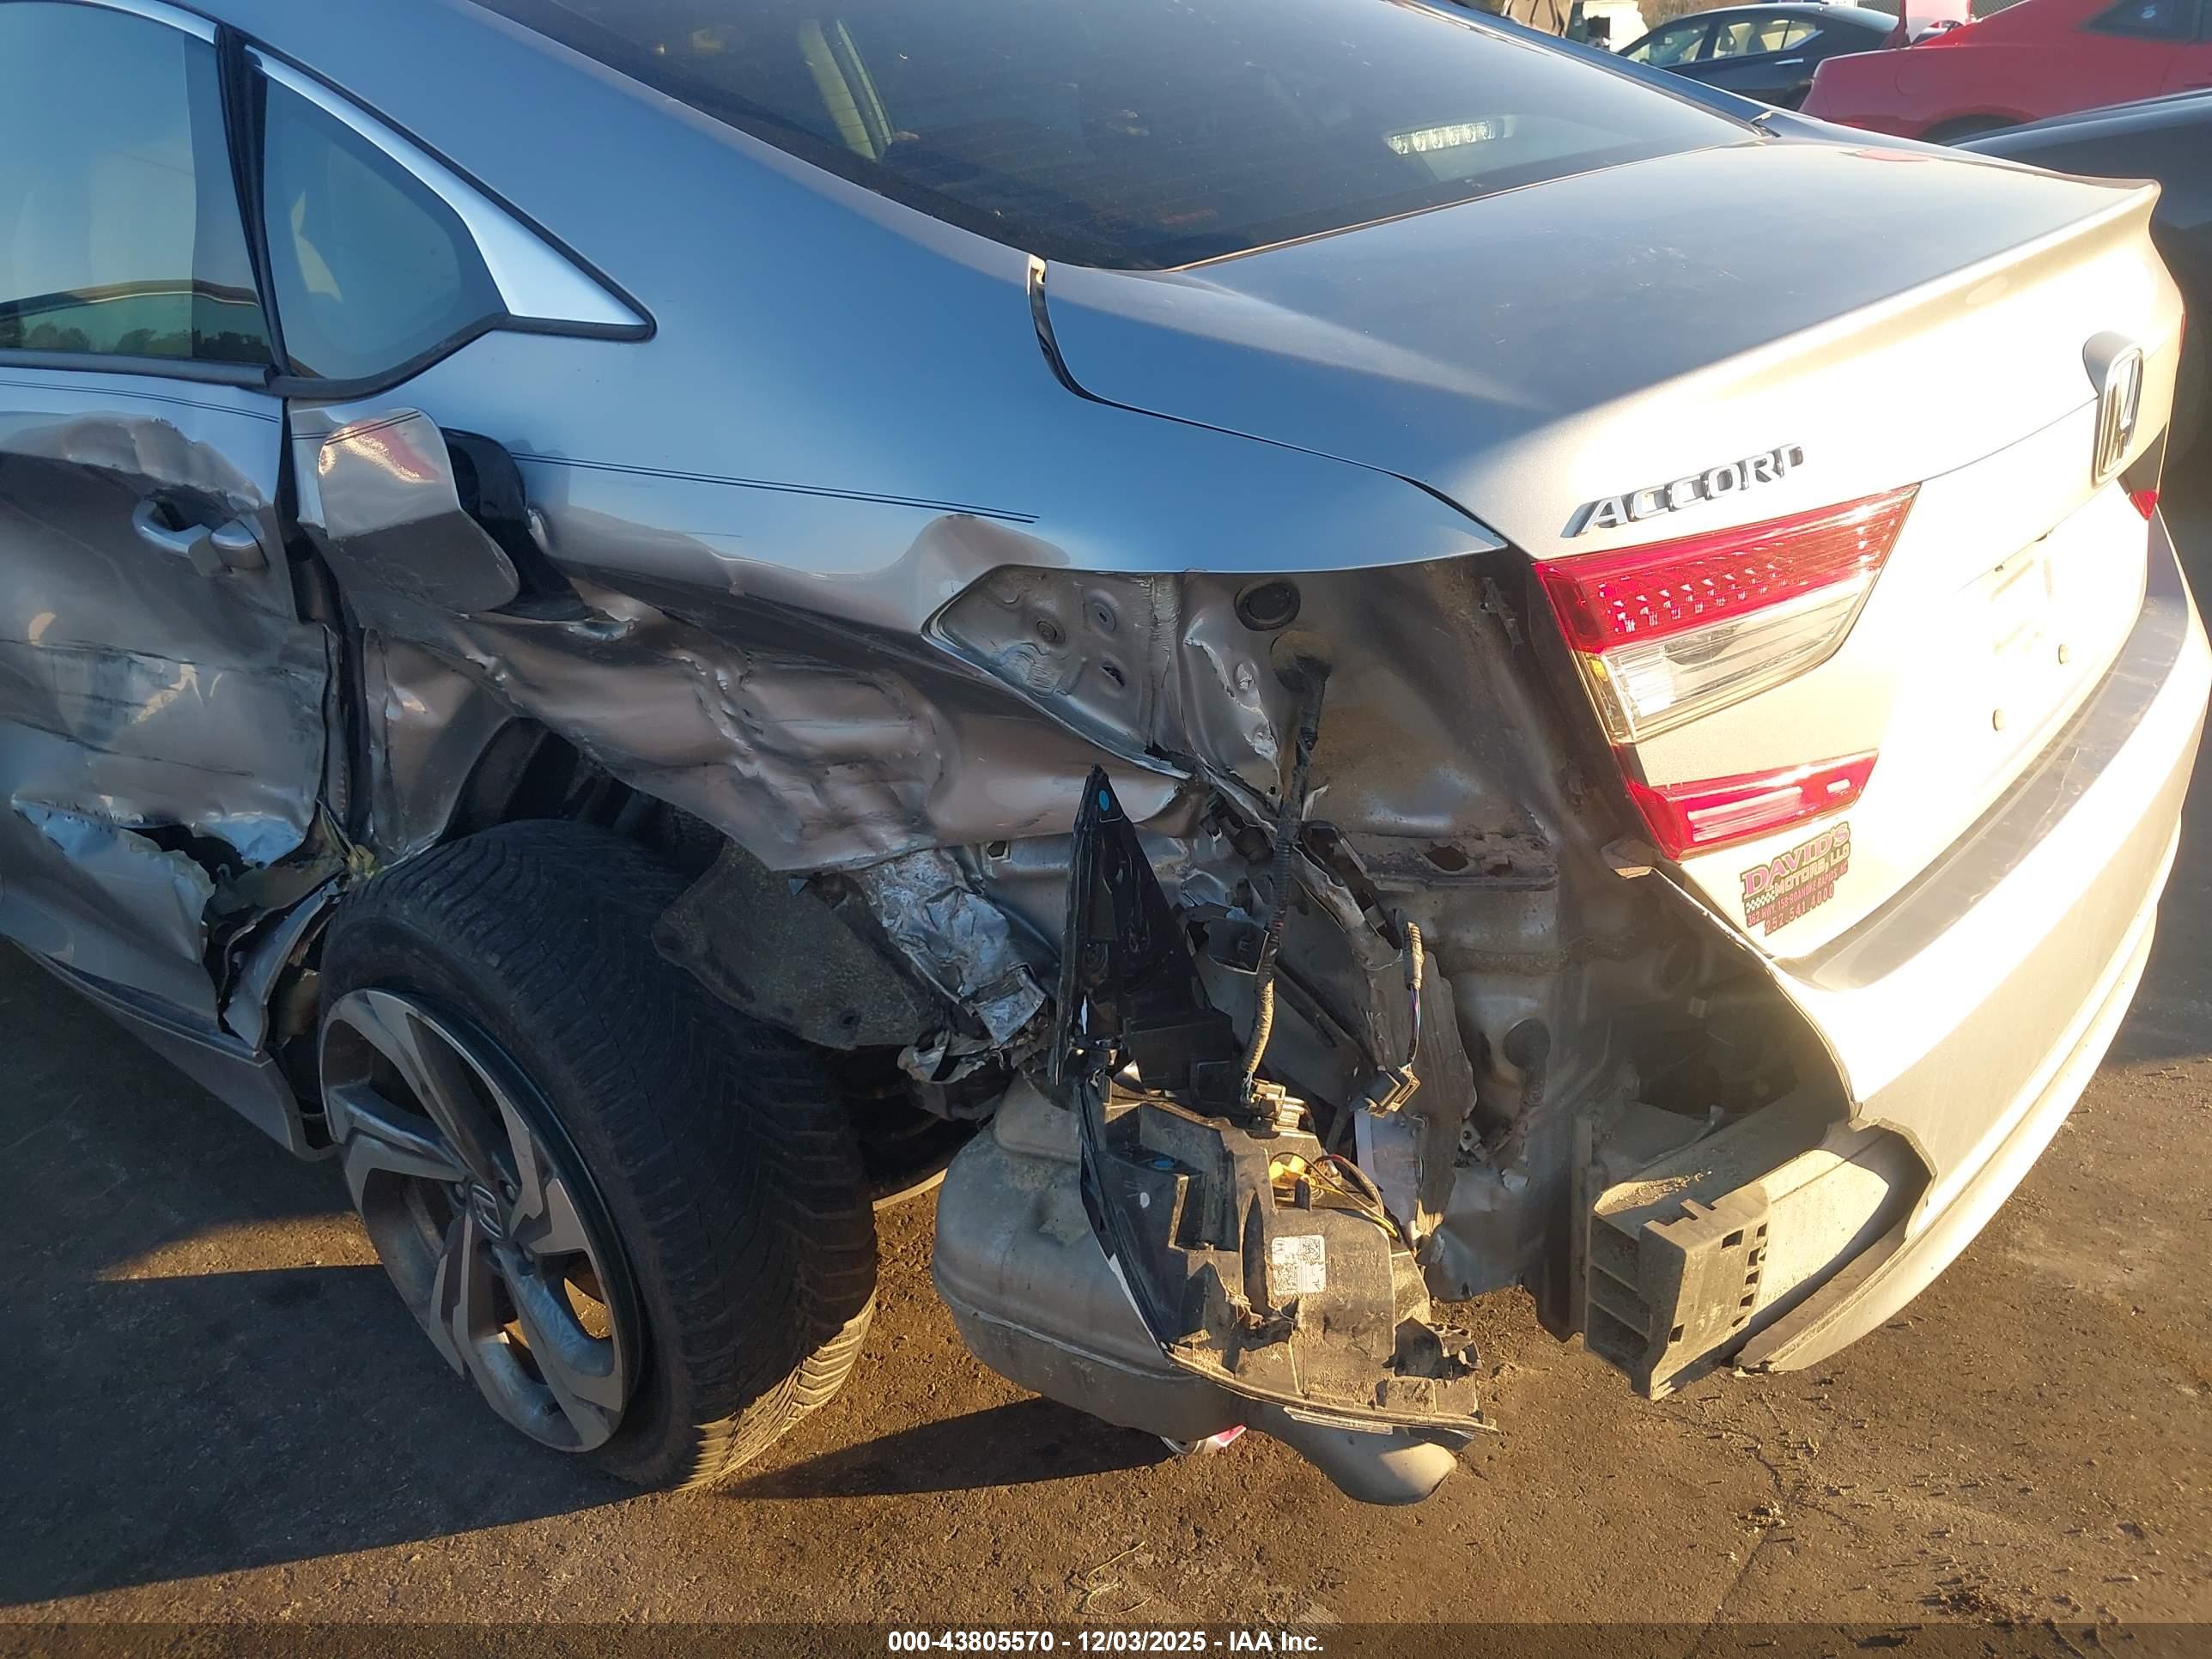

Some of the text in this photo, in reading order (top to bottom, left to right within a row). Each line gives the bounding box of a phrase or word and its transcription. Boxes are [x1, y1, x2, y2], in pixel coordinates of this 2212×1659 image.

[1559, 442, 1804, 538] ACCORD
[1741, 823, 1850, 899] DAVID'S
[1831, 843, 1850, 866] LLC
